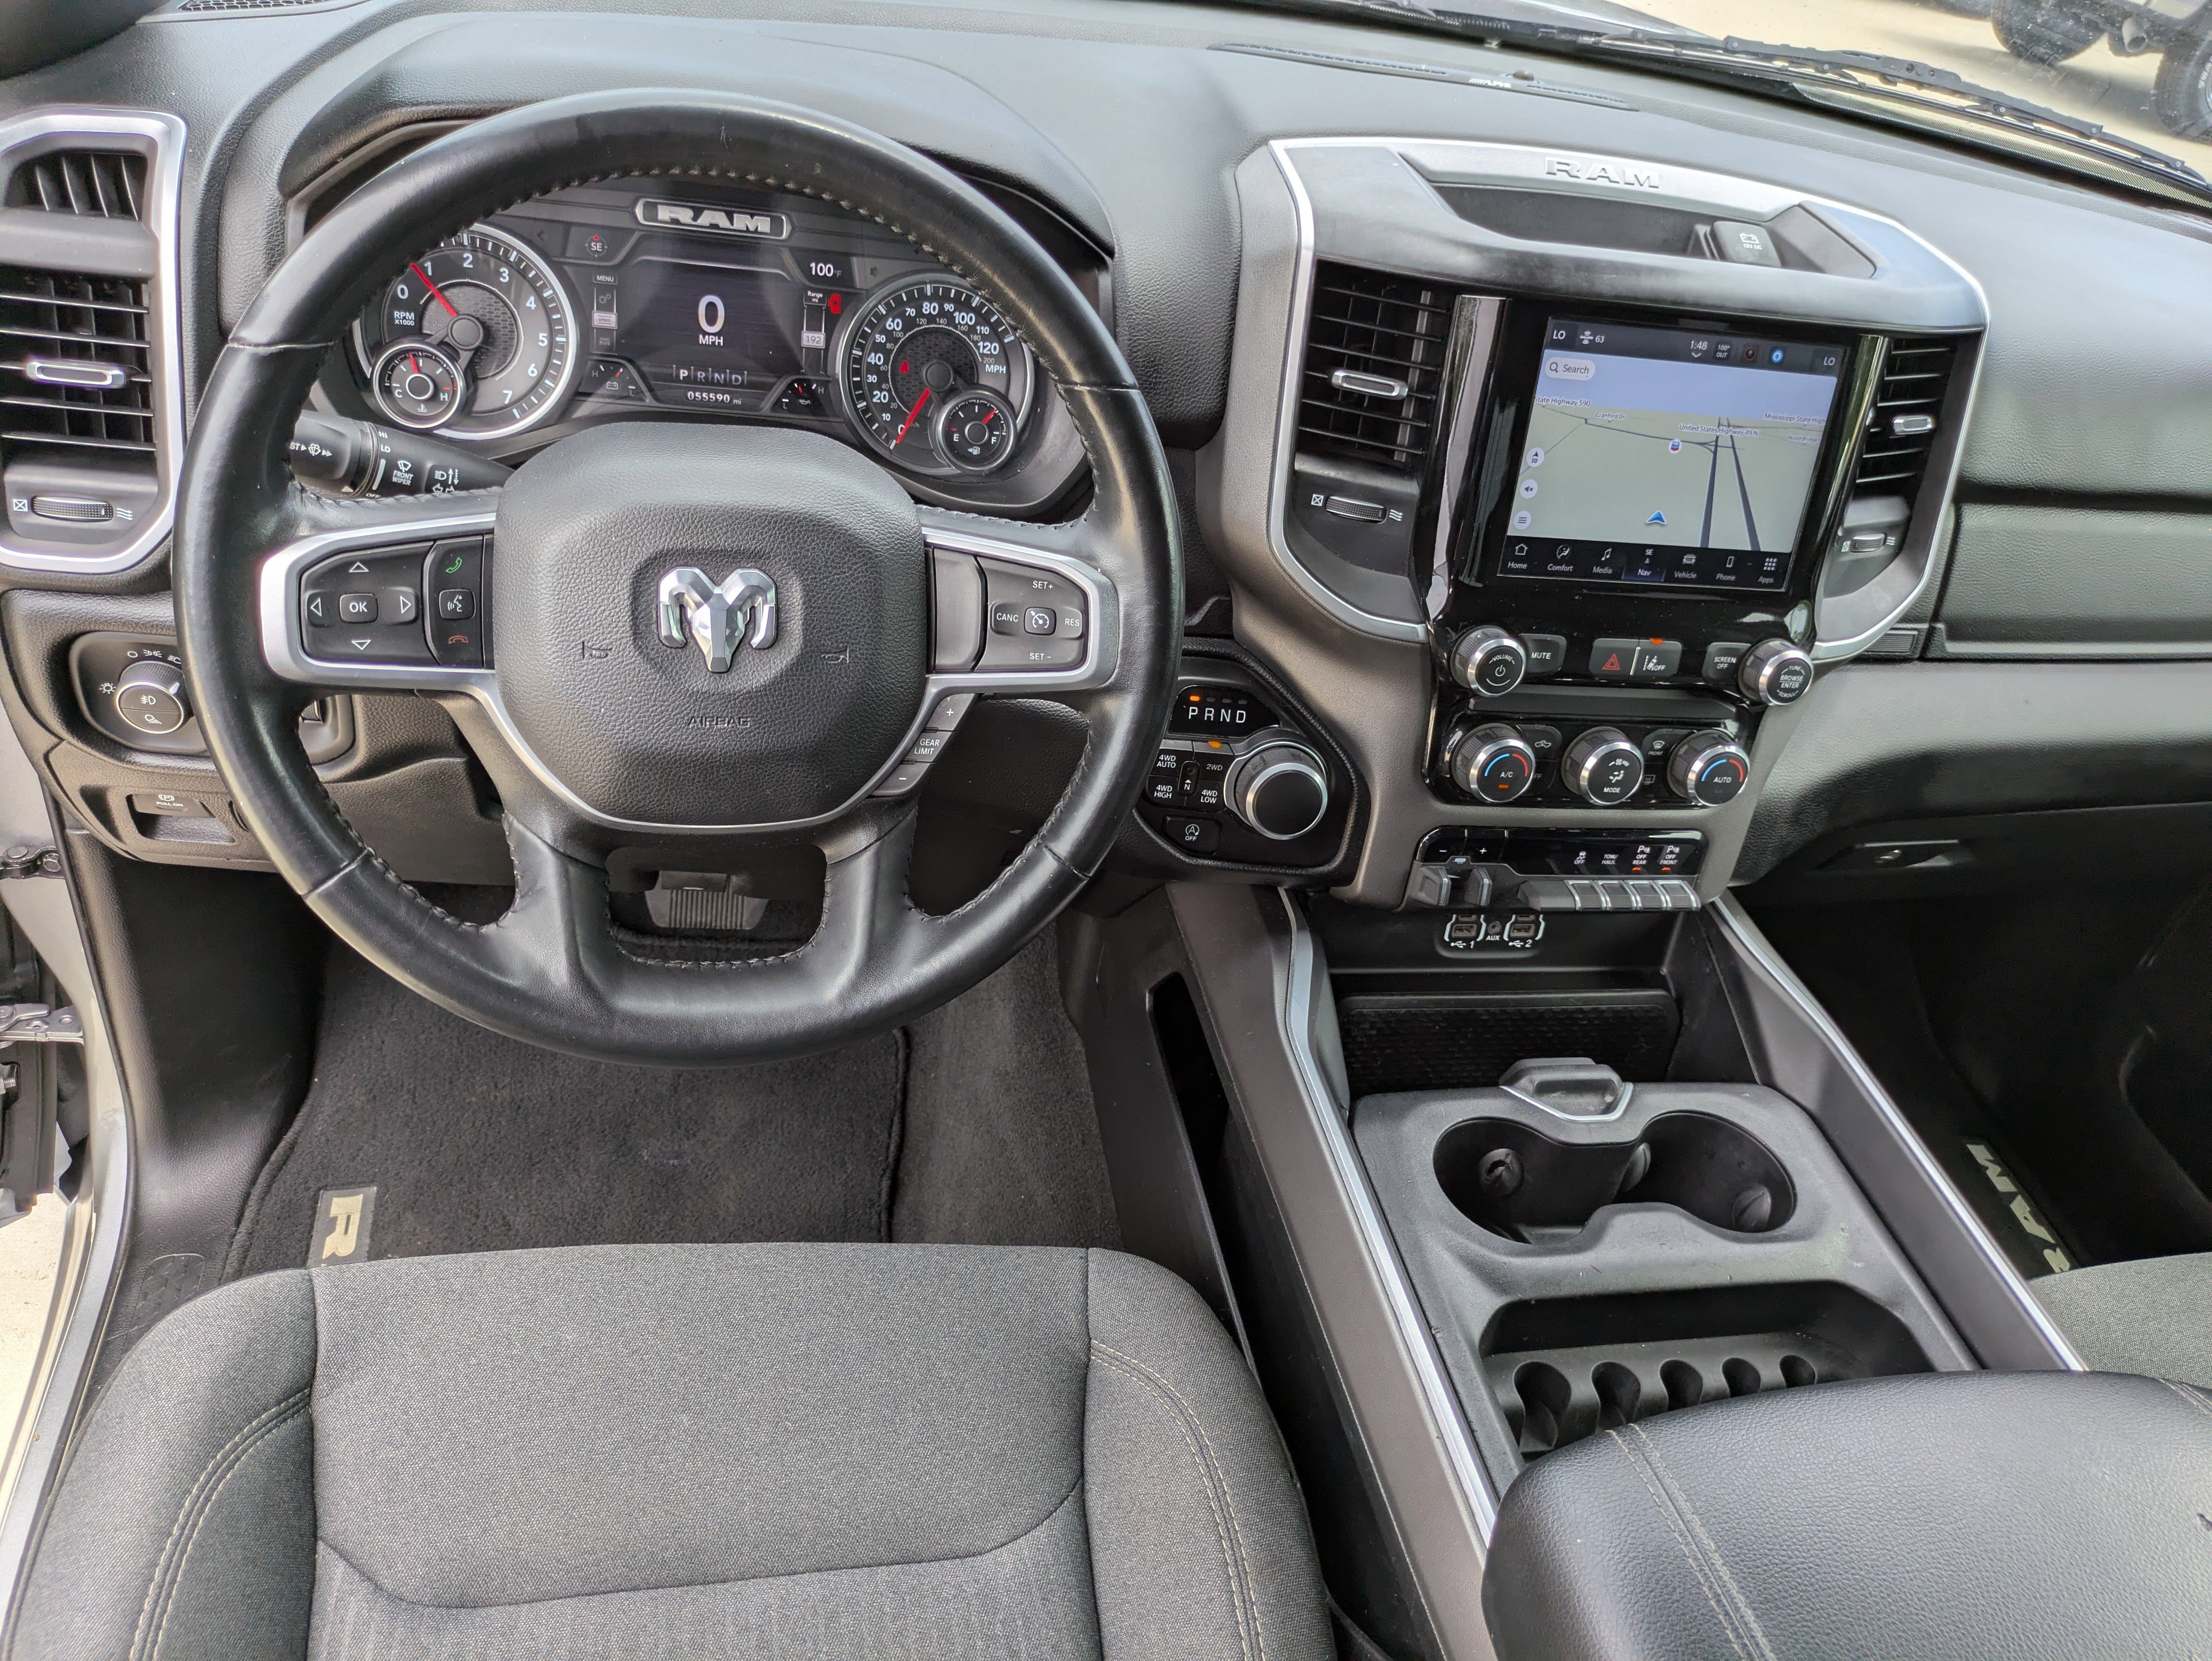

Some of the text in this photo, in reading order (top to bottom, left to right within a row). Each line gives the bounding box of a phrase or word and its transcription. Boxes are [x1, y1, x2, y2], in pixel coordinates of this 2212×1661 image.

[1544, 156, 1659, 189] RAM
[657, 205, 771, 233] RAM
[591, 242, 602, 251] SE
[464, 254, 473, 268] 2
[424, 263, 432, 276] 1
[499, 268, 509, 282] 3
[397, 285, 409, 299] 0
[526, 297, 536, 310] 4
[922, 301, 939, 315] 80
[943, 304, 954, 312] 90
[394, 311, 415, 321] RPM
[698, 295, 725, 333] 0
[905, 308, 916, 316] 70
[954, 312, 975, 325] 100
[885, 318, 902, 331] 60
[539, 333, 548, 346] 5
[699, 334, 723, 346] MPH
[806, 336, 821, 344] 192
[875, 335, 885, 343] 50
[1553, 330, 1566, 340] LO
[978, 342, 999, 354] 120
[1691, 340, 1708, 350] 1:48
[867, 353, 883, 365] 40
[1823, 357, 1836, 366] LO
[528, 364, 538, 376] 6
[985, 364, 1006, 374] MPH
[1562, 364, 1589, 375] Search
[679, 370, 741, 385] P R N D
[395, 389, 402, 398] C
[440, 393, 448, 401] H
[503, 390, 513, 404] 7
[687, 391, 730, 403] 055590
[873, 391, 889, 403] 20
[1550, 398, 1578, 407] Highway
[1764, 413, 1795, 422] Mississippi
[1700, 425, 1717, 433] States
[1717, 427, 1742, 436] Highway
[290, 442, 300, 451] ST
[381, 445, 391, 453] LO
[393, 471, 413, 480] FRONT
[392, 477, 412, 486] WIPER
[1548, 564, 1573, 572] Comfort
[1674, 571, 1697, 579] Vehicle
[1758, 576, 1774, 584] Apps
[349, 602, 368, 612] OK
[996, 613, 1018, 622] CANC
[1064, 618, 1080, 627] RES
[1492, 654, 1513, 662] VOLUME
[1188, 707, 1246, 723] P R N D
[688, 716, 750, 728] AIRBAG
[920, 738, 940, 746] GEAR
[914, 747, 934, 755] LIMIT
[1154, 791, 1172, 799] HIGH
[1201, 789, 1218, 797] 4WD
[1201, 796, 1217, 804] LOW
[1470, 941, 1475, 949] 1
[1525, 940, 1533, 948] 2
